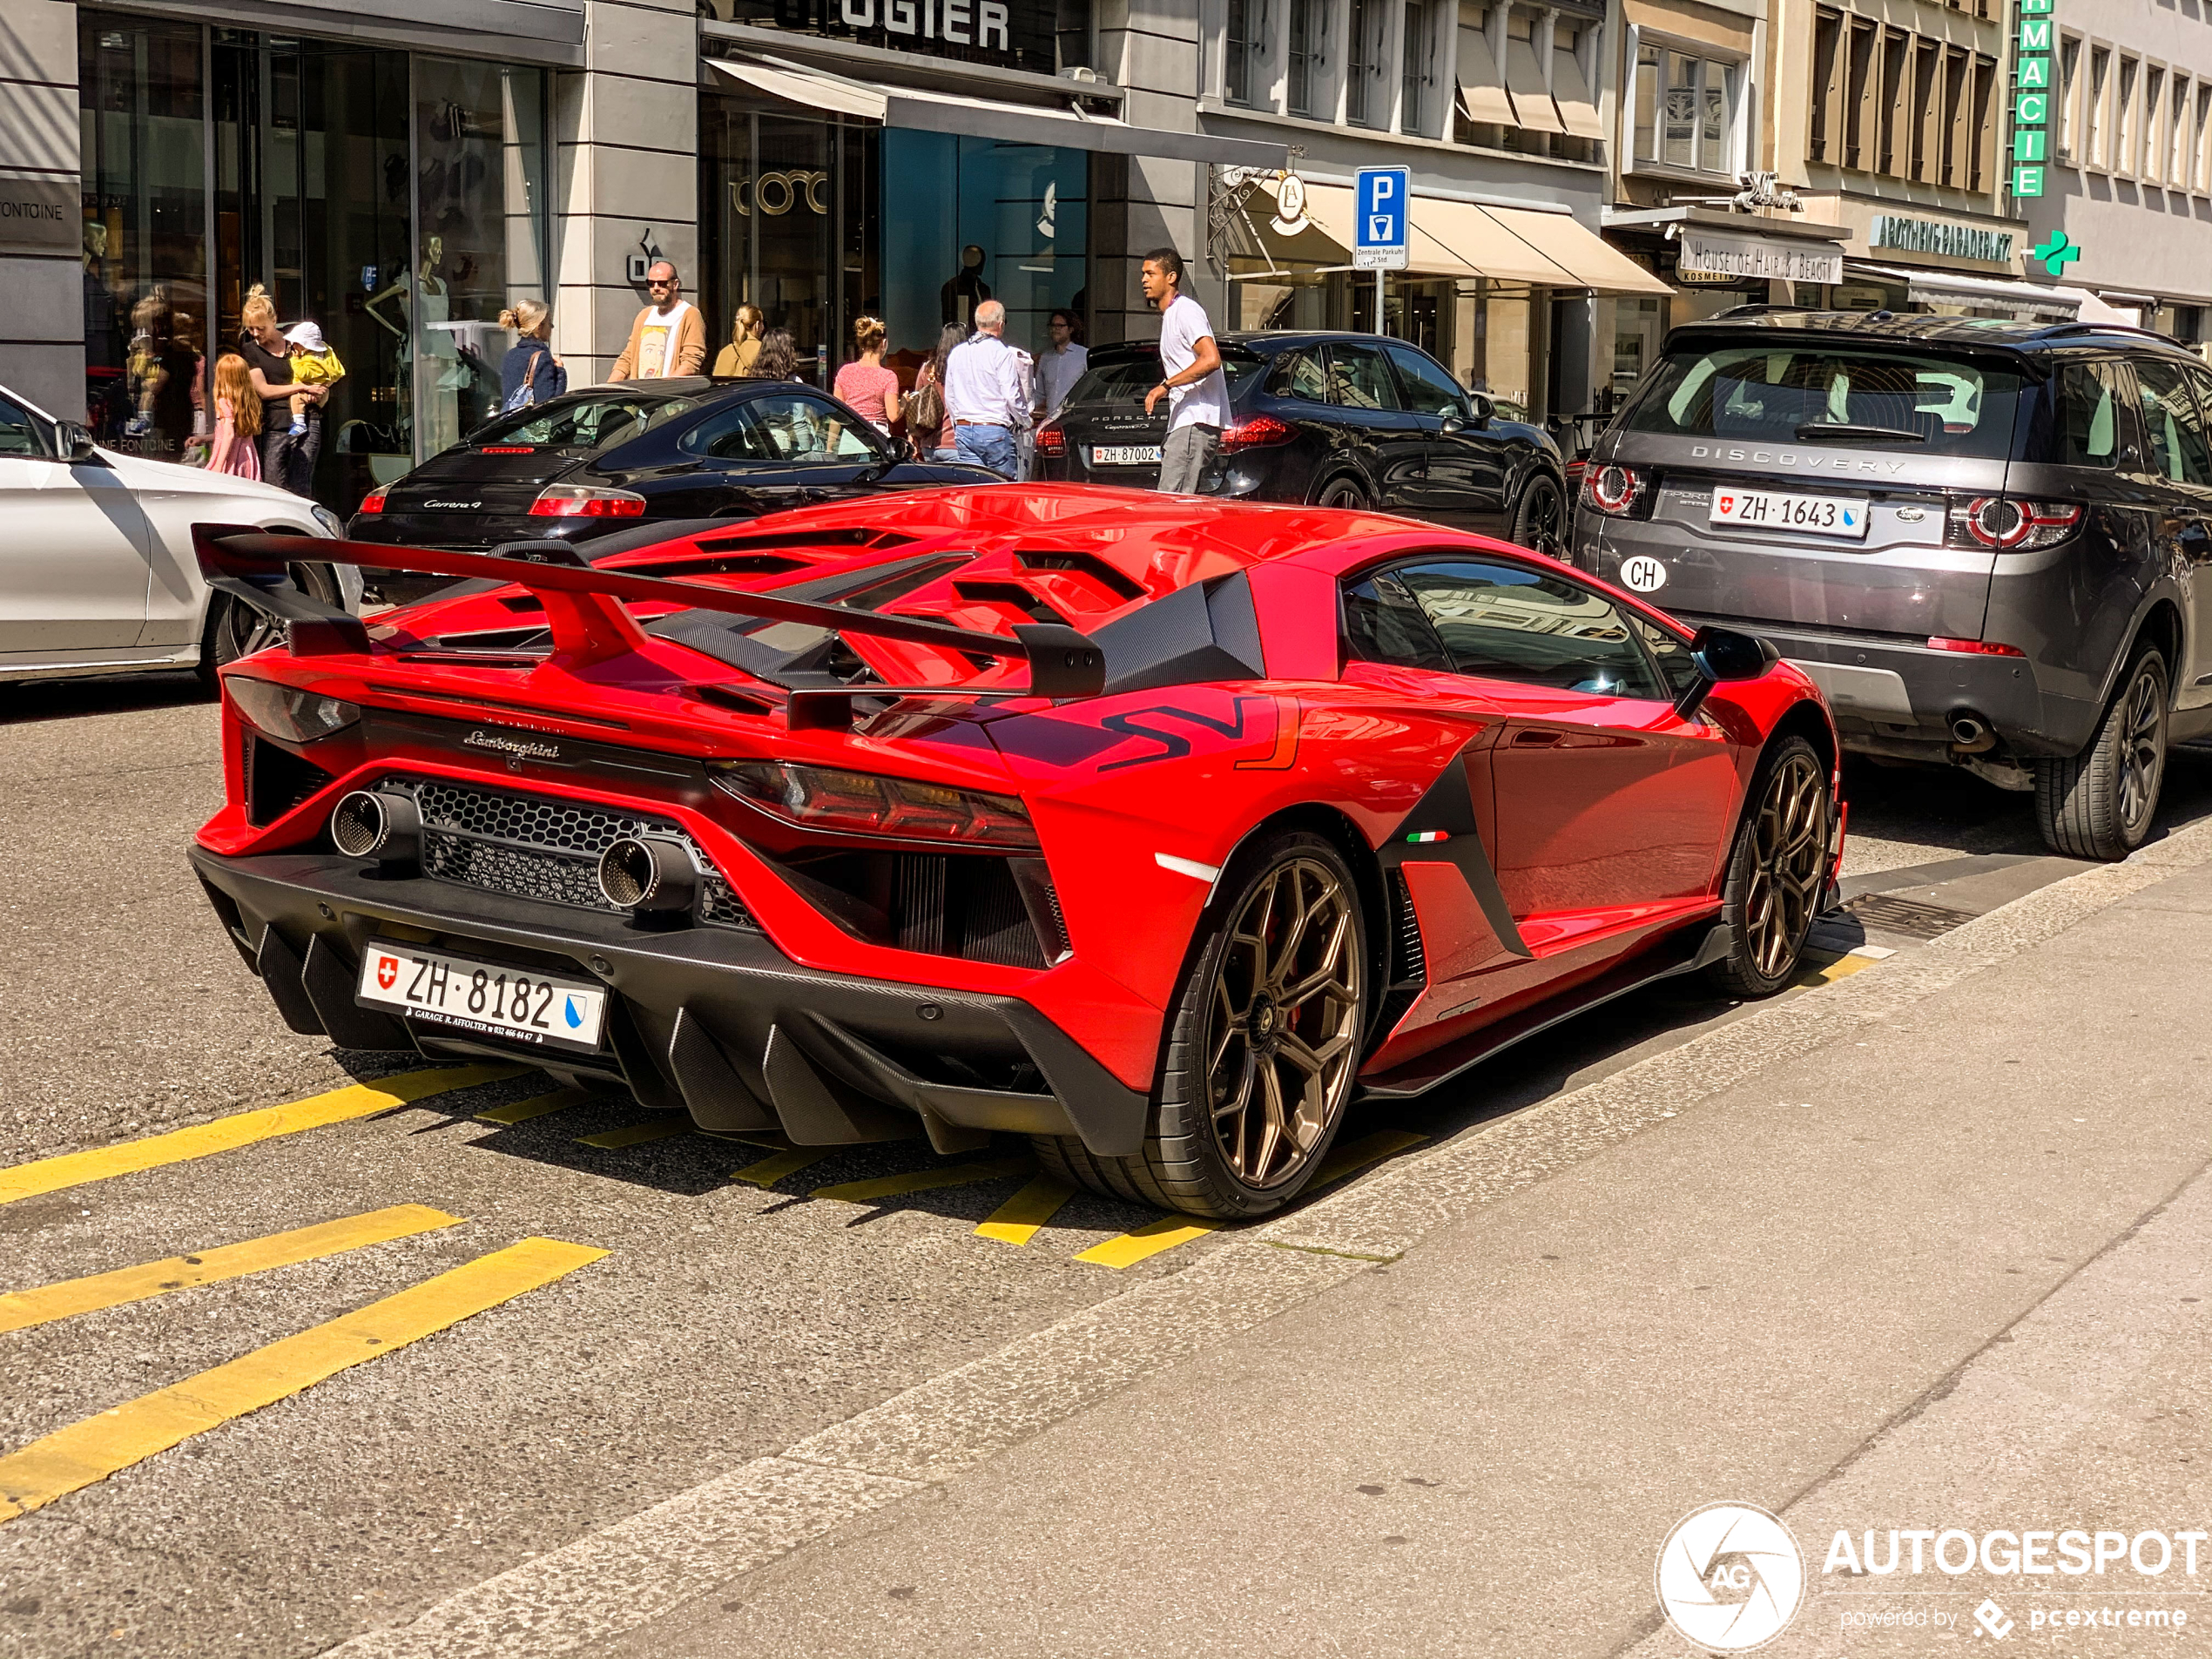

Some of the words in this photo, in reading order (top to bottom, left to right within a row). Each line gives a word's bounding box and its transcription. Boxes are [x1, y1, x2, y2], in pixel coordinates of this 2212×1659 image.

[1372, 176, 1393, 212] P
[0, 201, 64, 220] ONTAINE
[1878, 215, 1941, 253] APOTHEKE
[1941, 225, 2013, 263] PARADEPLATZ
[1691, 445, 1906, 473] DISCOVERY
[424, 500, 470, 509] Carrera
[1663, 490, 1711, 500] SPORT
[1631, 561, 1656, 588] CH
[463, 730, 559, 760] Lamborghini
[415, 1010, 444, 1022] GARAGE
[445, 1015, 452, 1024] R.
[452, 1017, 488, 1031] AFFOLTER
[494, 1026, 505, 1035] 032
[505, 1028, 516, 1037] 466
